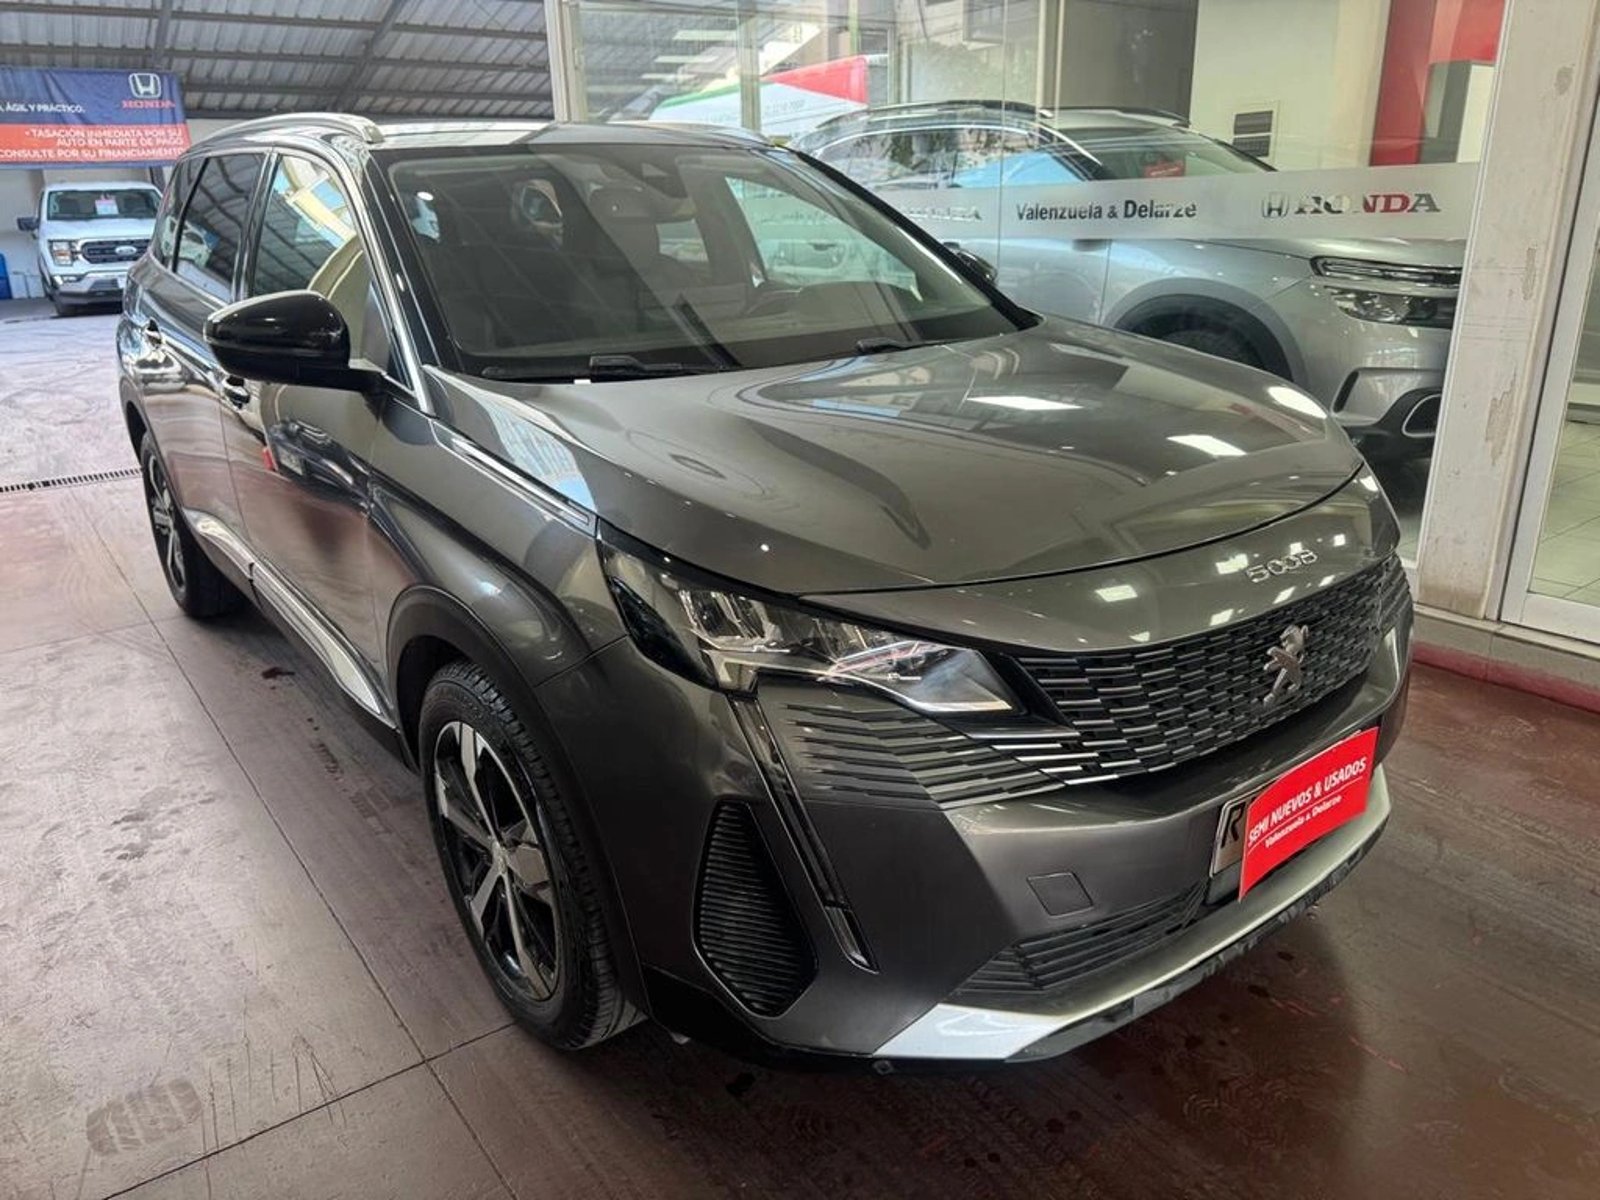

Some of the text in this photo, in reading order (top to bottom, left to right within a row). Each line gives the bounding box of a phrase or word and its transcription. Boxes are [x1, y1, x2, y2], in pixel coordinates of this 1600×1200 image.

[122, 100, 175, 109] HONDA
[87, 129, 143, 138] INMEDIATA
[145, 129, 165, 138] POR
[167, 128, 182, 138] SU
[57, 138, 84, 147] AUTO
[87, 138, 103, 147] EN
[104, 137, 138, 147] PARTE
[141, 137, 154, 146] DE
[57, 149, 80, 158] POR
[82, 149, 97, 158] SU
[1016, 199, 1198, 221] Valenzuela & Delarze
[1246, 549, 1318, 583] 5008
[1248, 756, 1368, 848] SEMI NUEVOS & USADOS
